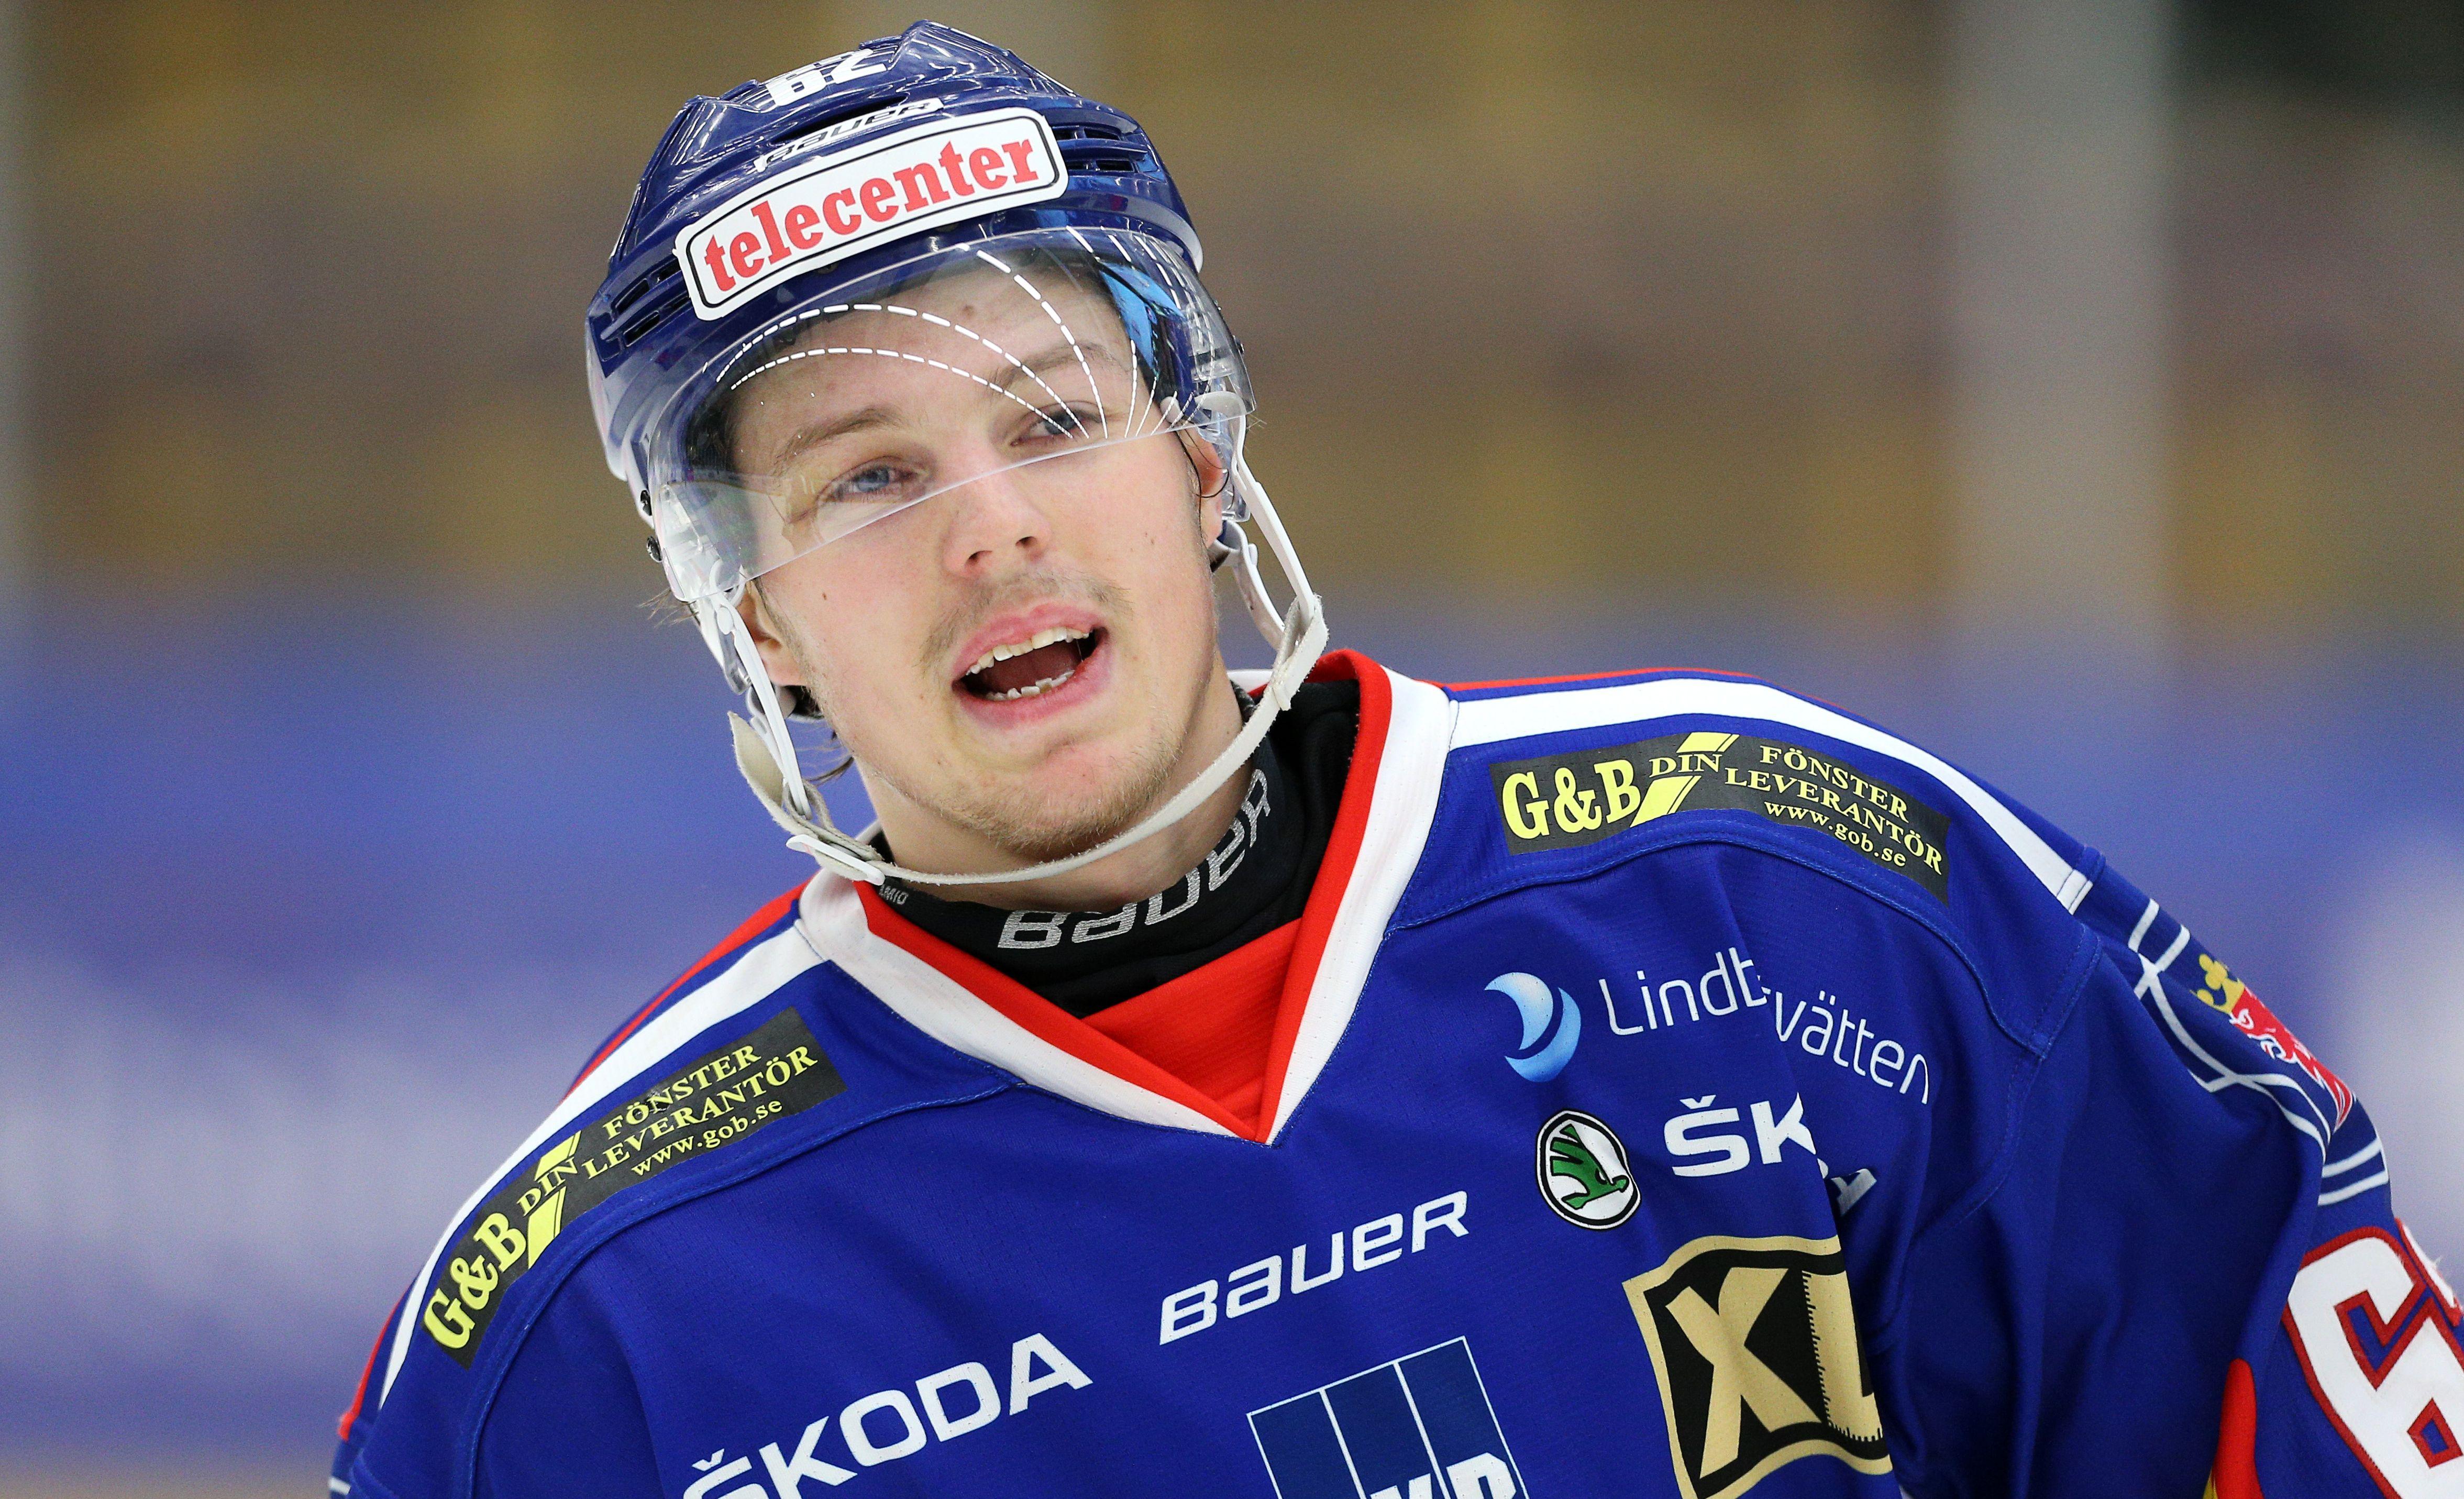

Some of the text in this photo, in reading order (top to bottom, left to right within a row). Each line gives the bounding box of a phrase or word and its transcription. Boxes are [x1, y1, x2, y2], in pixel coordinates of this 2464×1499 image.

[705, 137, 1038, 292] telecenter
[1502, 758, 1641, 840] G&B
[1649, 754, 1722, 779] DIN
[1760, 744, 1909, 824] FÖNSTER
[1725, 767, 1943, 875] LEVERANTÖR
[1764, 800, 1906, 868] www.gob.se
[581, 1045, 817, 1180] LEVERANTÖR
[603, 1044, 761, 1140] FÖNSTER
[631, 1099, 782, 1177] www.gob.se
[517, 1156, 578, 1217] DIN
[423, 1212, 527, 1349] G&B
[683, 1332, 1093, 1499] ŠKODA
